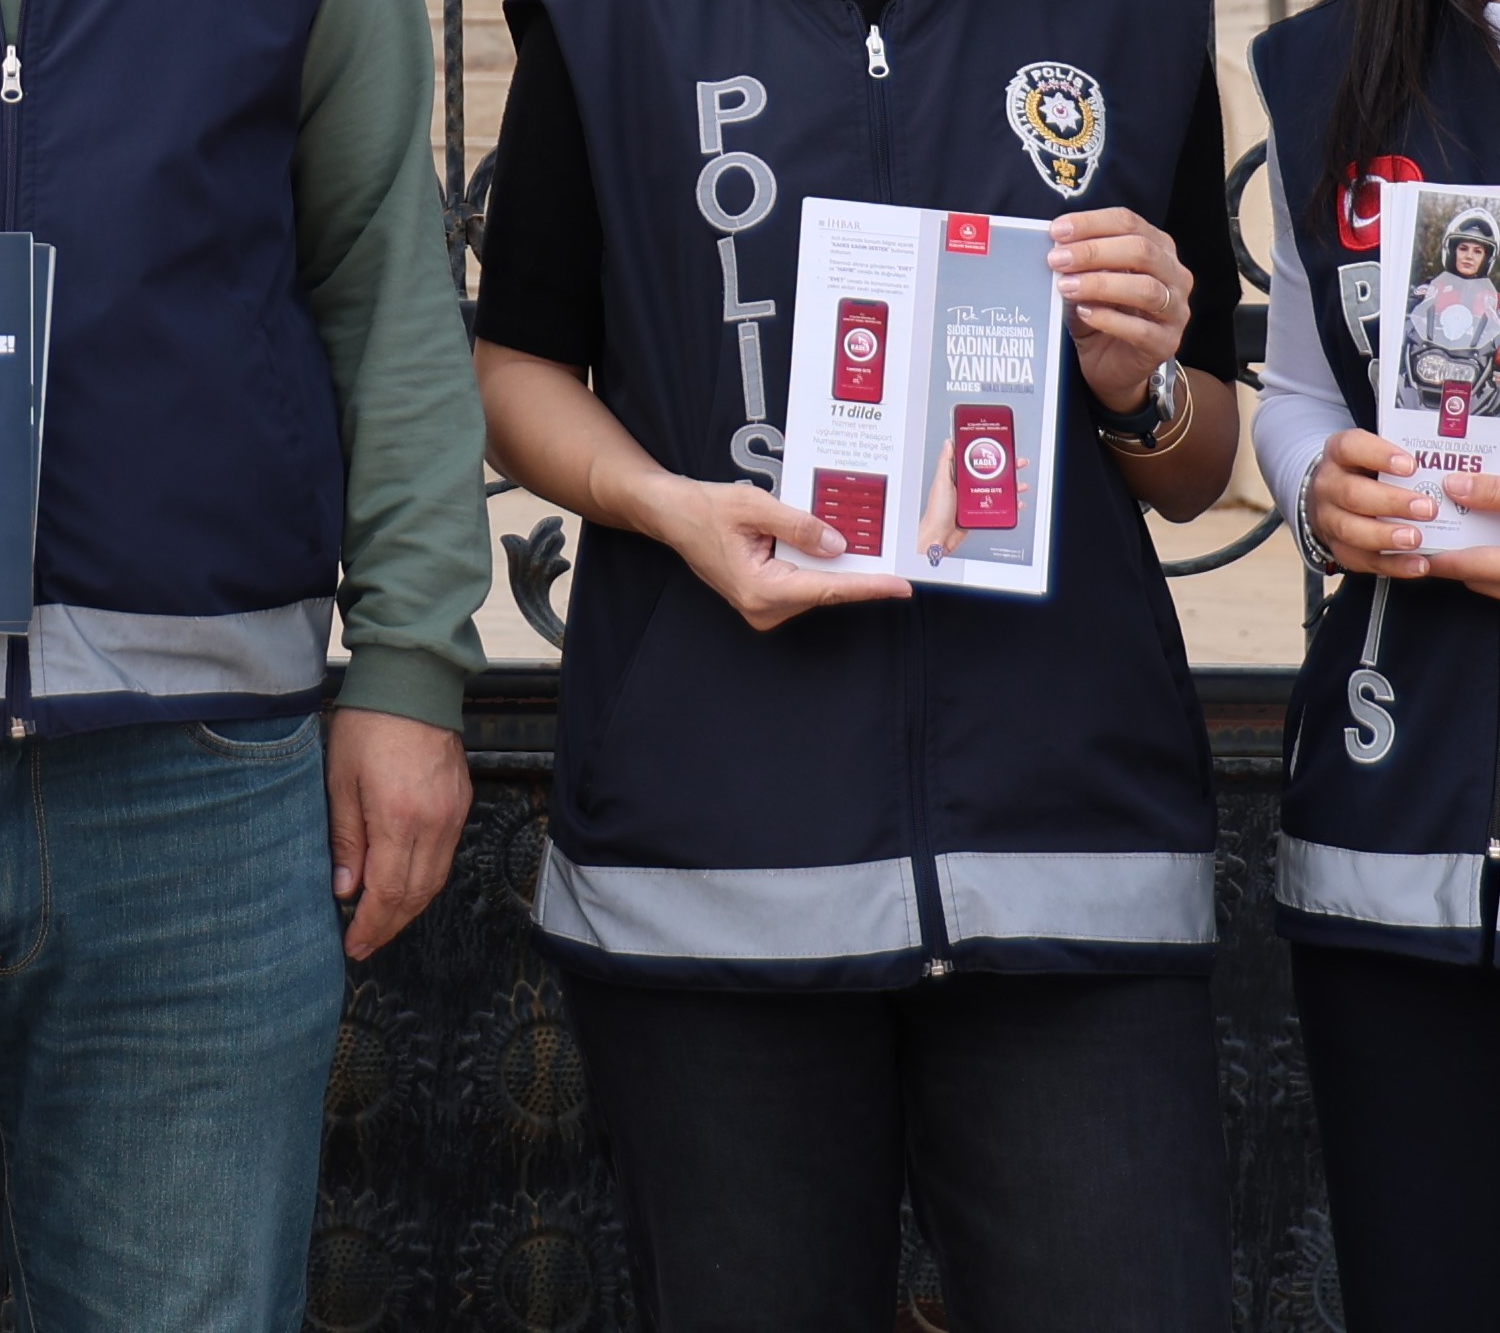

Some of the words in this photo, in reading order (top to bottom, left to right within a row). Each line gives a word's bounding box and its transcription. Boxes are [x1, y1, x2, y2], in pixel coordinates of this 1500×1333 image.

[1030, 67, 1083, 88] POLİS
[696, 75, 787, 500] POLİS
[947, 305, 979, 325] Tek
[947, 336, 1034, 357] KADINLARIN
[947, 355, 1033, 383] YANINDA
[946, 381, 981, 393] KADES
[831, 404, 844, 417] 11
[848, 405, 882, 421] dilde
[1415, 449, 1483, 474] KADES
